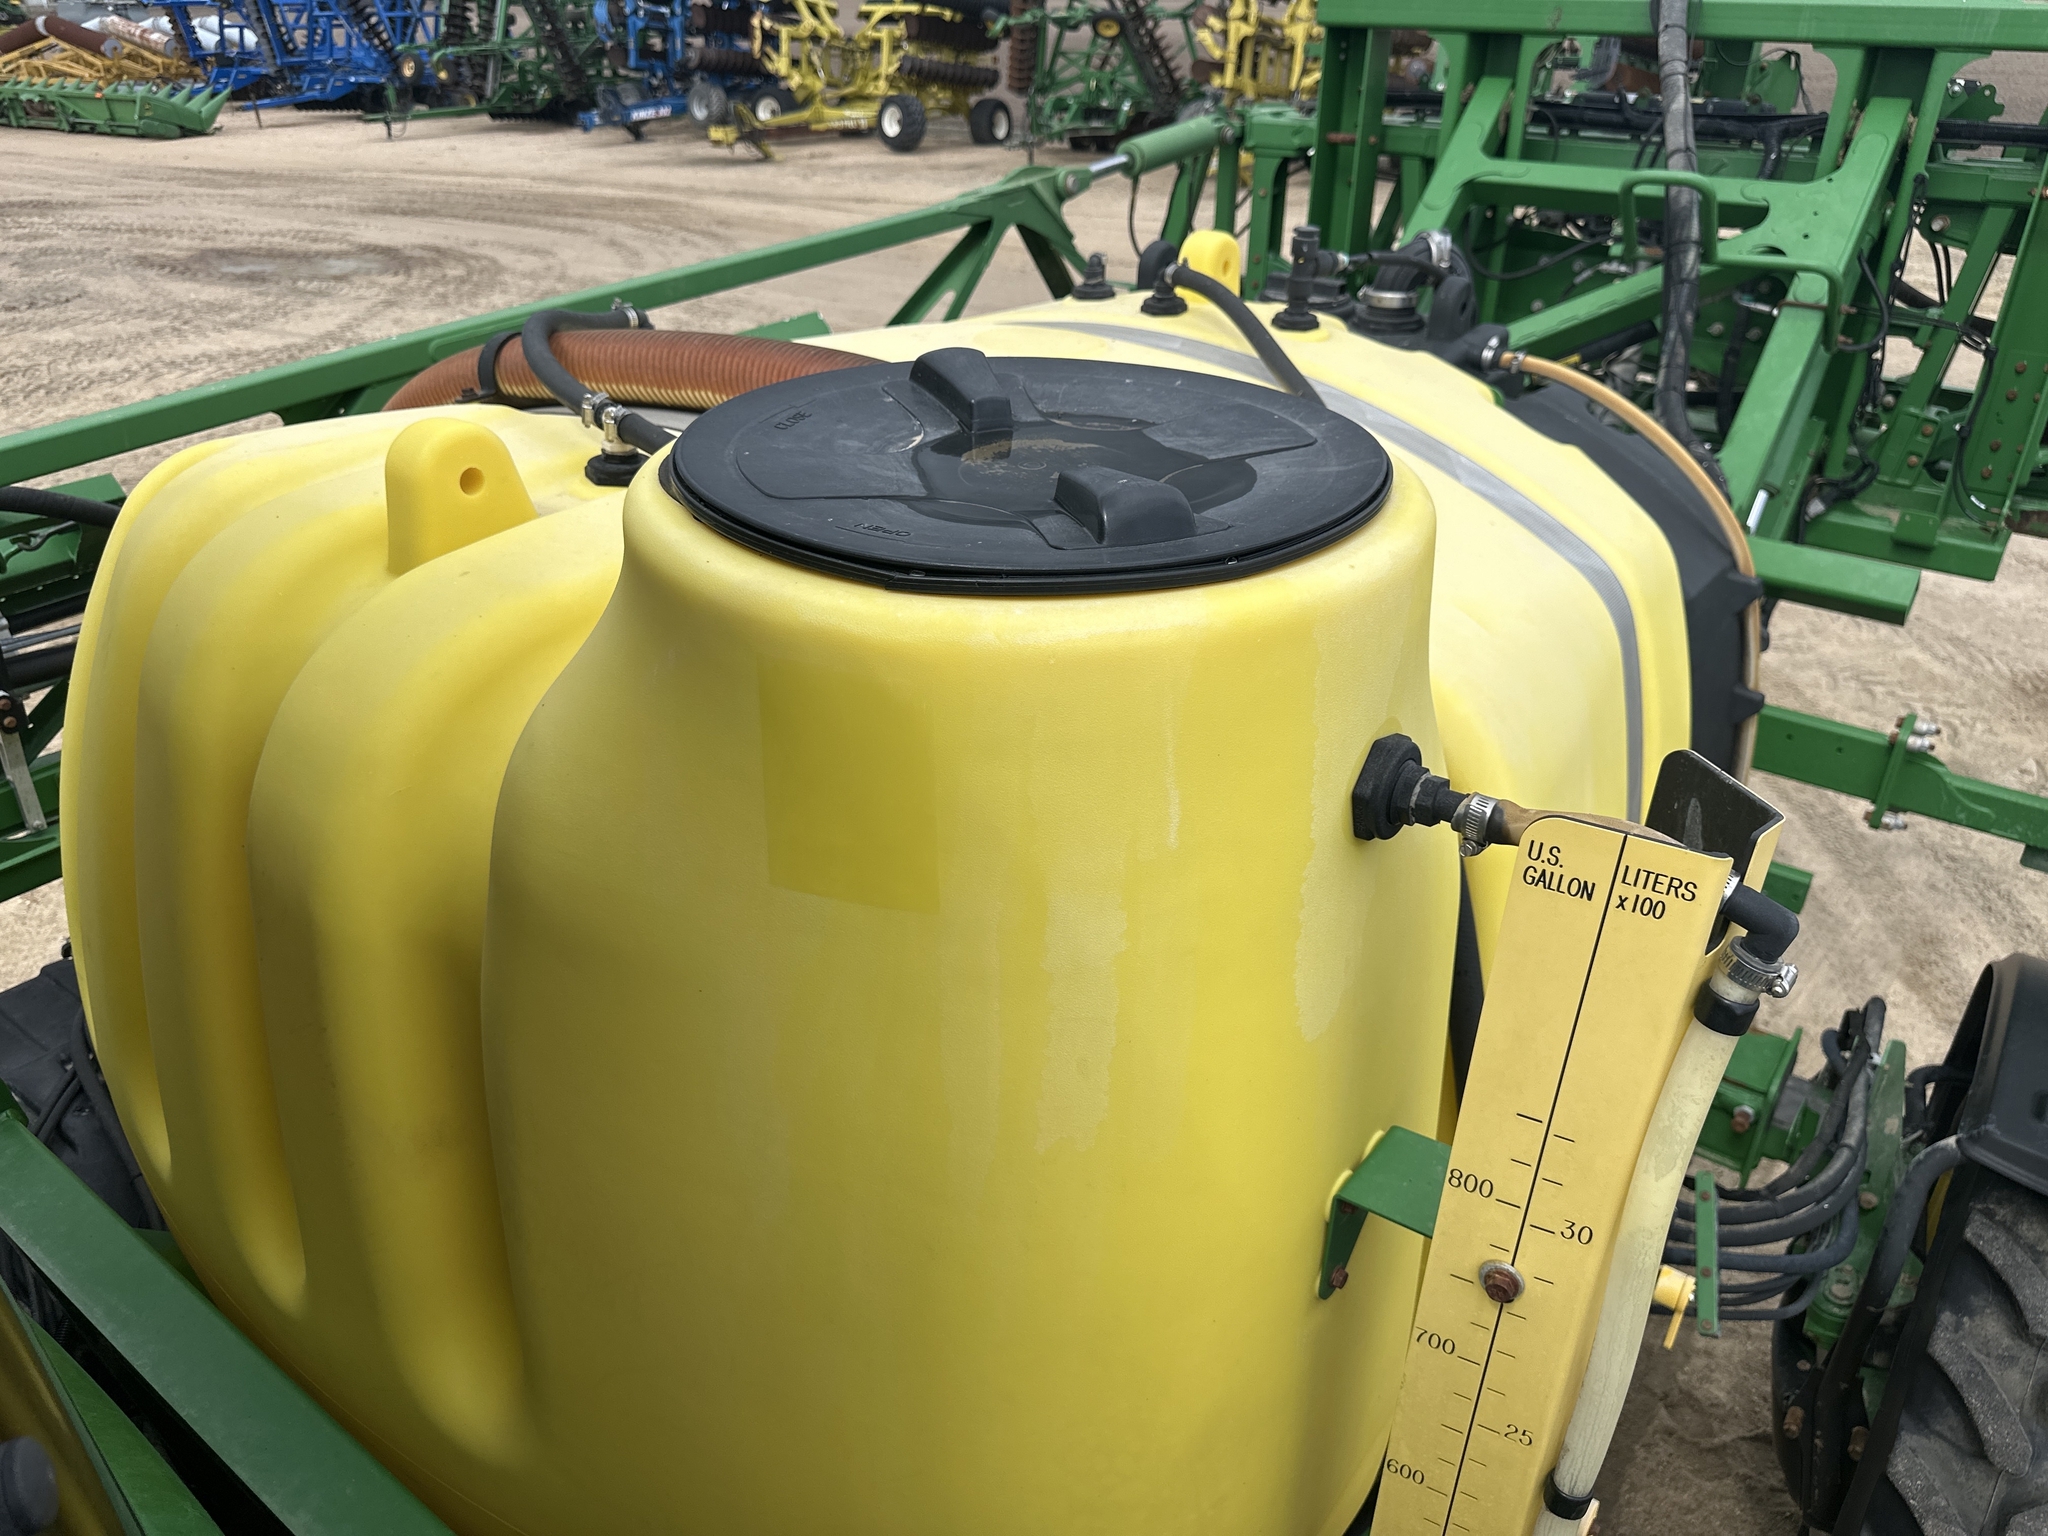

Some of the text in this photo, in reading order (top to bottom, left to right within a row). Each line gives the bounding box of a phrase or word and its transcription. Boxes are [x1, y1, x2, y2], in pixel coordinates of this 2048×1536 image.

[773, 410, 813, 430] CLOSE
[853, 522, 911, 537] OPEN
[1527, 839, 1564, 869] U.S.
[1522, 865, 1596, 902] GALLON
[1620, 864, 1698, 902] LITERS
[1615, 893, 1666, 920] x100
[1447, 1168, 1494, 1198] 800
[1560, 1219, 1593, 1245] 30
[1415, 1326, 1456, 1355] 700
[1503, 1423, 1534, 1447] 25
[1386, 1458, 1425, 1485] 600
